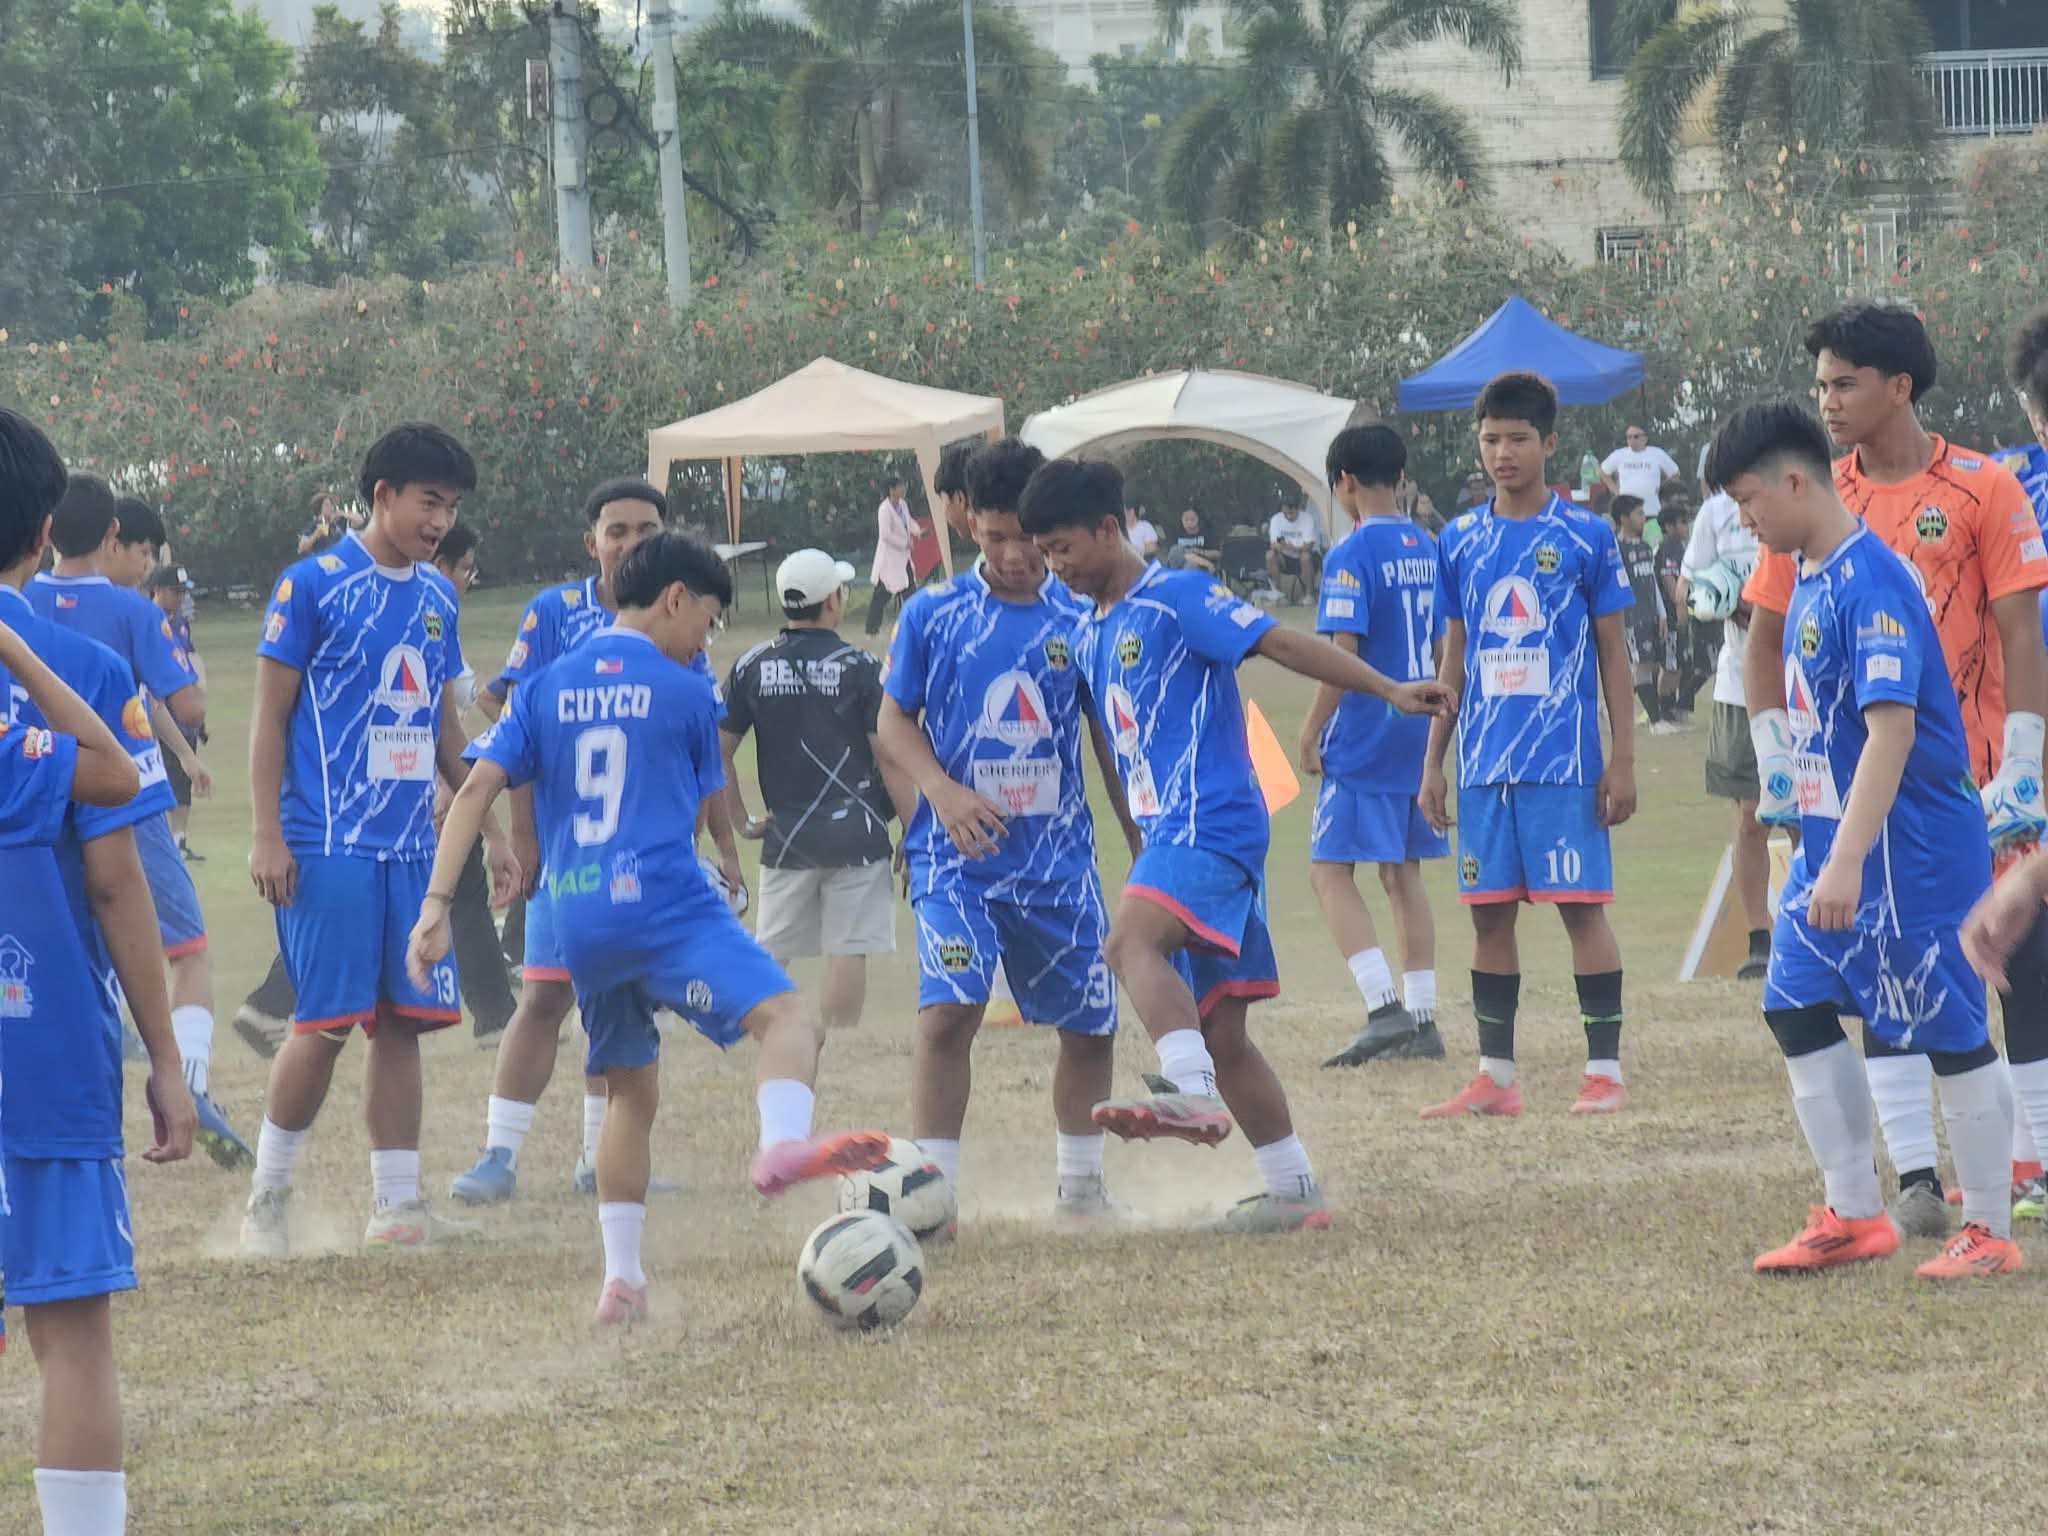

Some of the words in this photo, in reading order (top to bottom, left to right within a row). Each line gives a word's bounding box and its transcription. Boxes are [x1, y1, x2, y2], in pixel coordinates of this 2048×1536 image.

[558, 684, 651, 723] CUYCO
[573, 724, 628, 848] 9
[1545, 847, 1581, 884] 10
[433, 963, 455, 1005] 13
